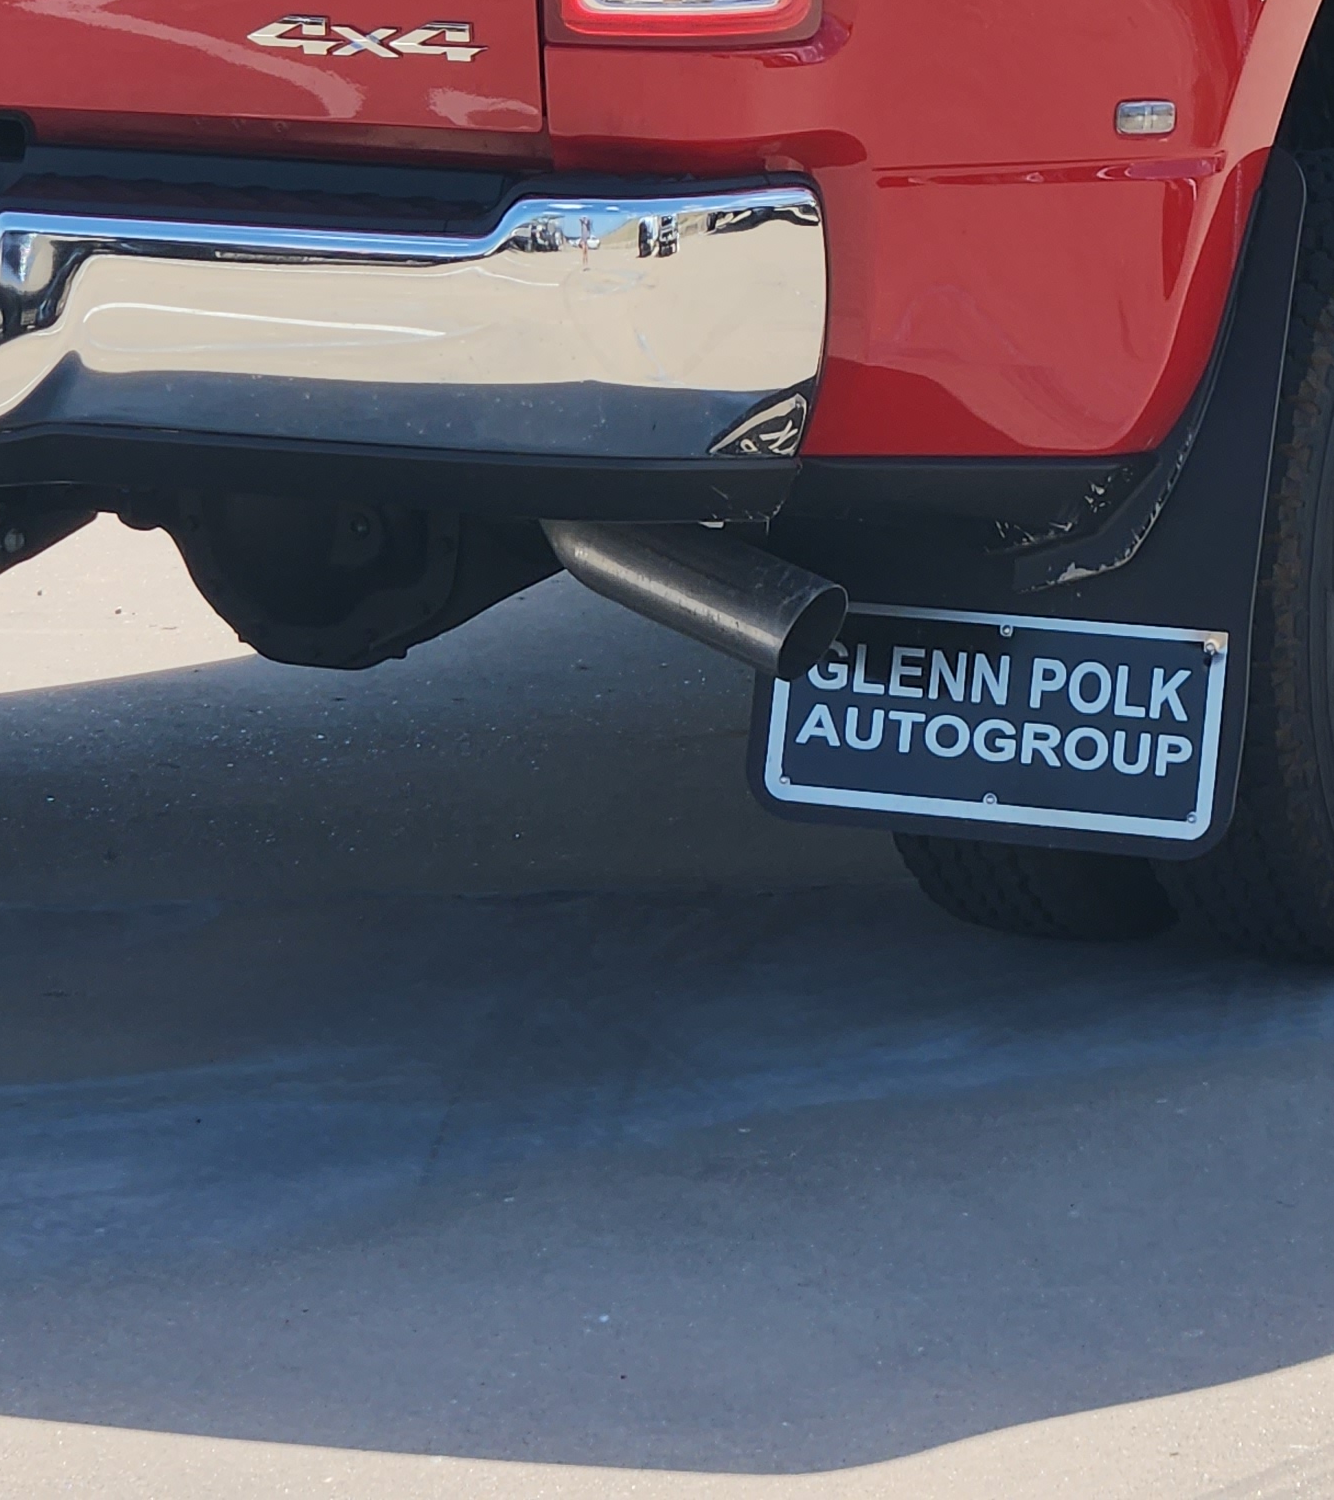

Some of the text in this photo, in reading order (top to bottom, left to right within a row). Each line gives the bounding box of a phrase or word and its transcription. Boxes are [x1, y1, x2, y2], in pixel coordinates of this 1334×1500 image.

[807, 641, 1192, 722] GLENN POLK
[795, 703, 1193, 777] AUTOGROUP
